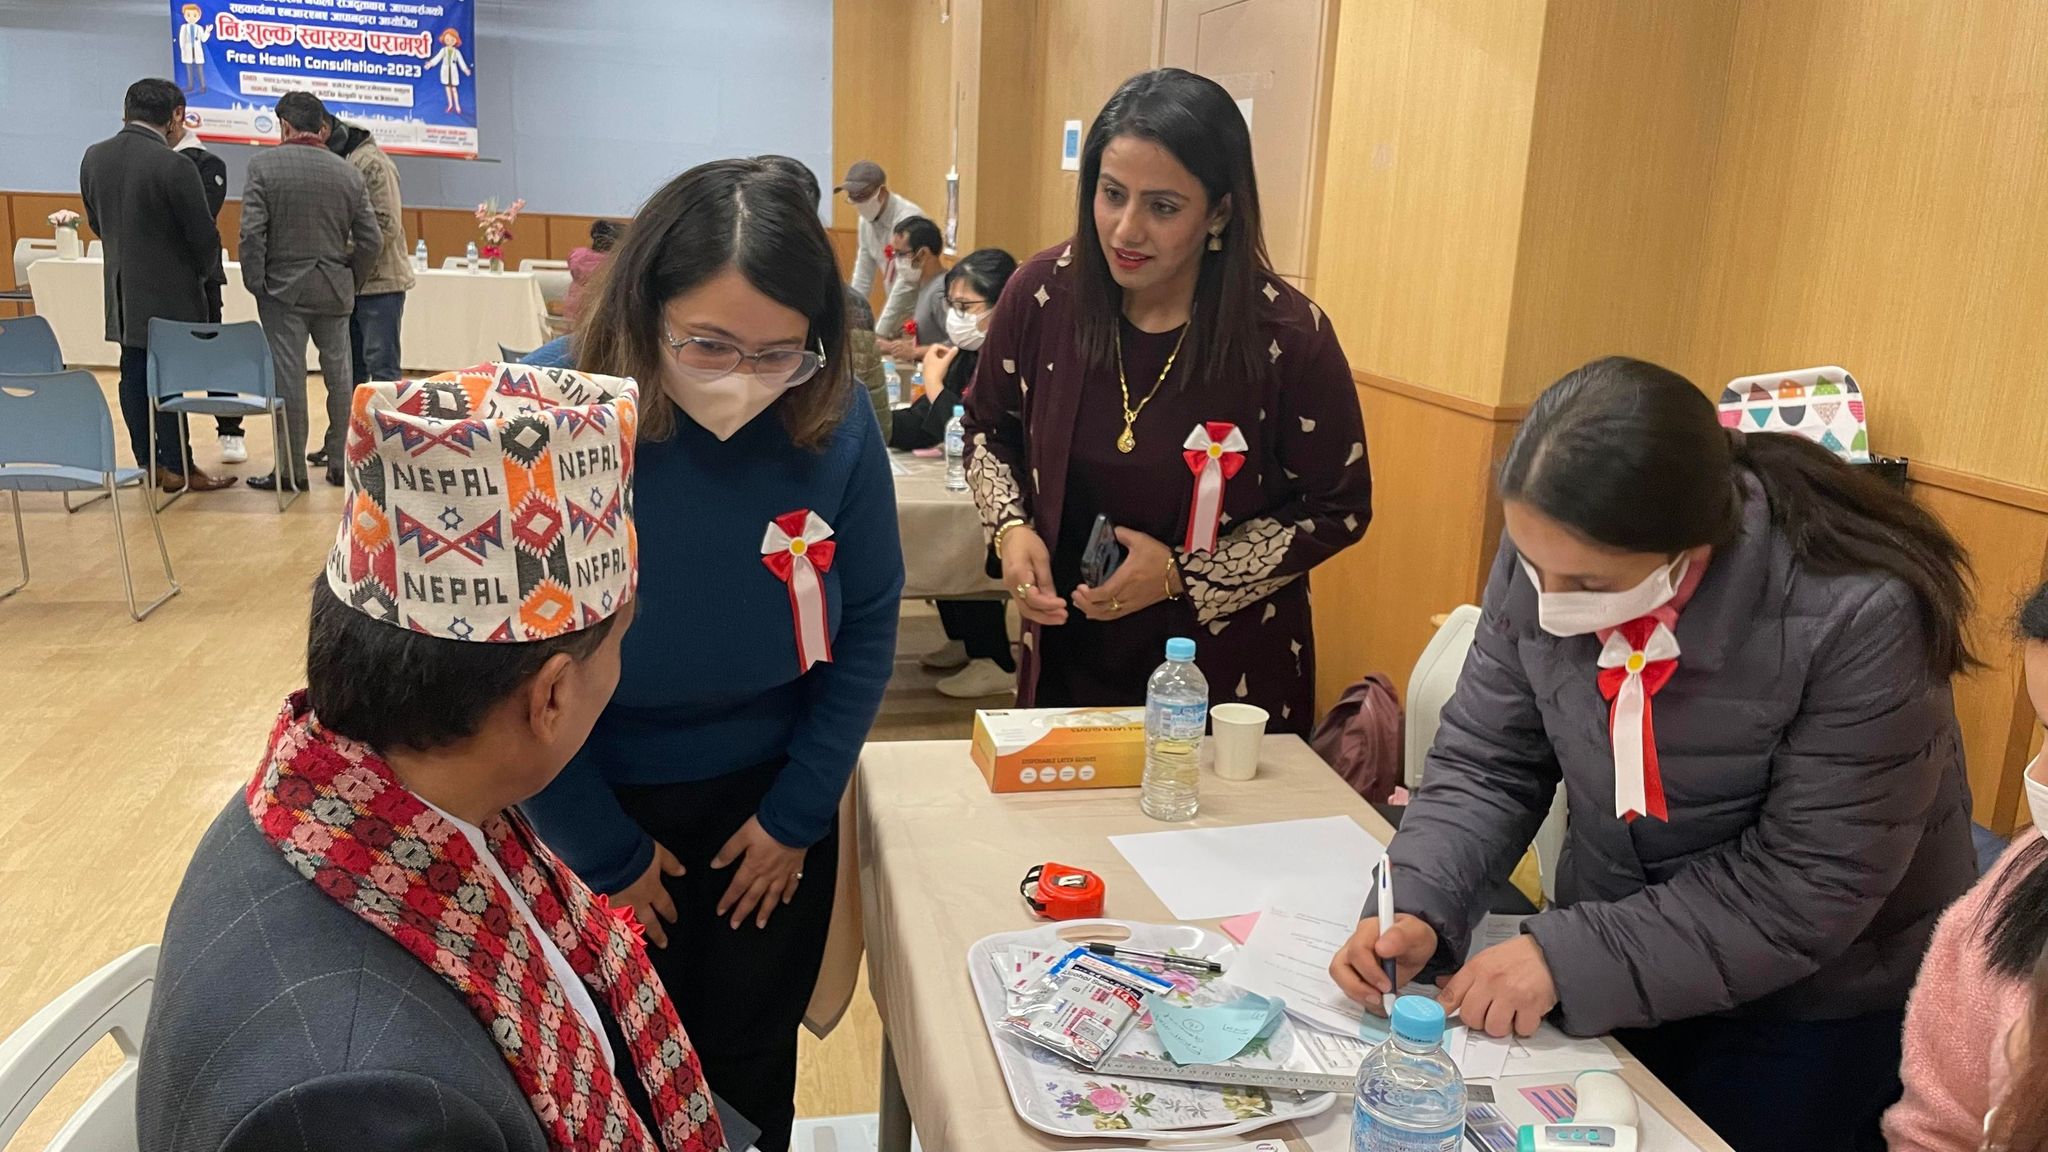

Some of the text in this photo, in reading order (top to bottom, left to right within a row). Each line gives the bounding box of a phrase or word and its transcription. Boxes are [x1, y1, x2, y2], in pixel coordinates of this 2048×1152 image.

[368, 32, 431, 55] परामर्श
[226, 50, 422, 78] Free Health Consultation-2023
[547, 367, 591, 407] NEP
[393, 462, 499, 497] NEPAL
[558, 444, 619, 482] NEPAL
[575, 546, 628, 588] NEPAL
[404, 570, 509, 606] NEPAL
